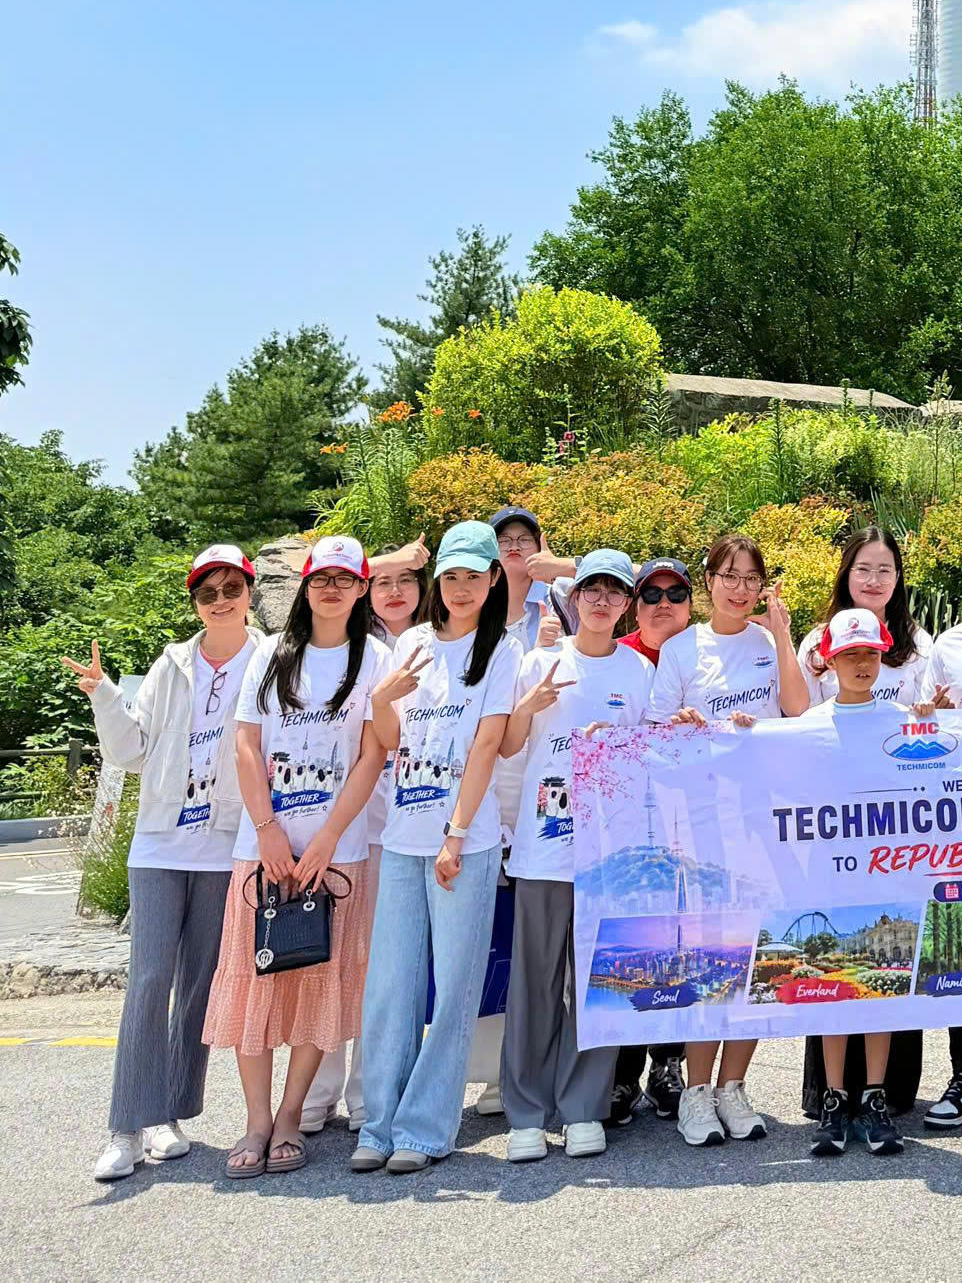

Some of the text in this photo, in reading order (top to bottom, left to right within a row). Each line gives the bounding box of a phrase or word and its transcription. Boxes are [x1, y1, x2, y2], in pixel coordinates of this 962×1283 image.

[707, 686, 771, 715] TECHMICOM
[279, 708, 350, 728] TECHMICOM
[405, 704, 465, 725] TECHMICOM
[900, 722, 939, 736] TMC
[897, 762, 946, 771] TECHMICOM
[280, 793, 320, 808] TOGETHER
[832, 856, 857, 872] TO
[652, 989, 680, 1005] Seoul
[796, 983, 840, 998] Everland
